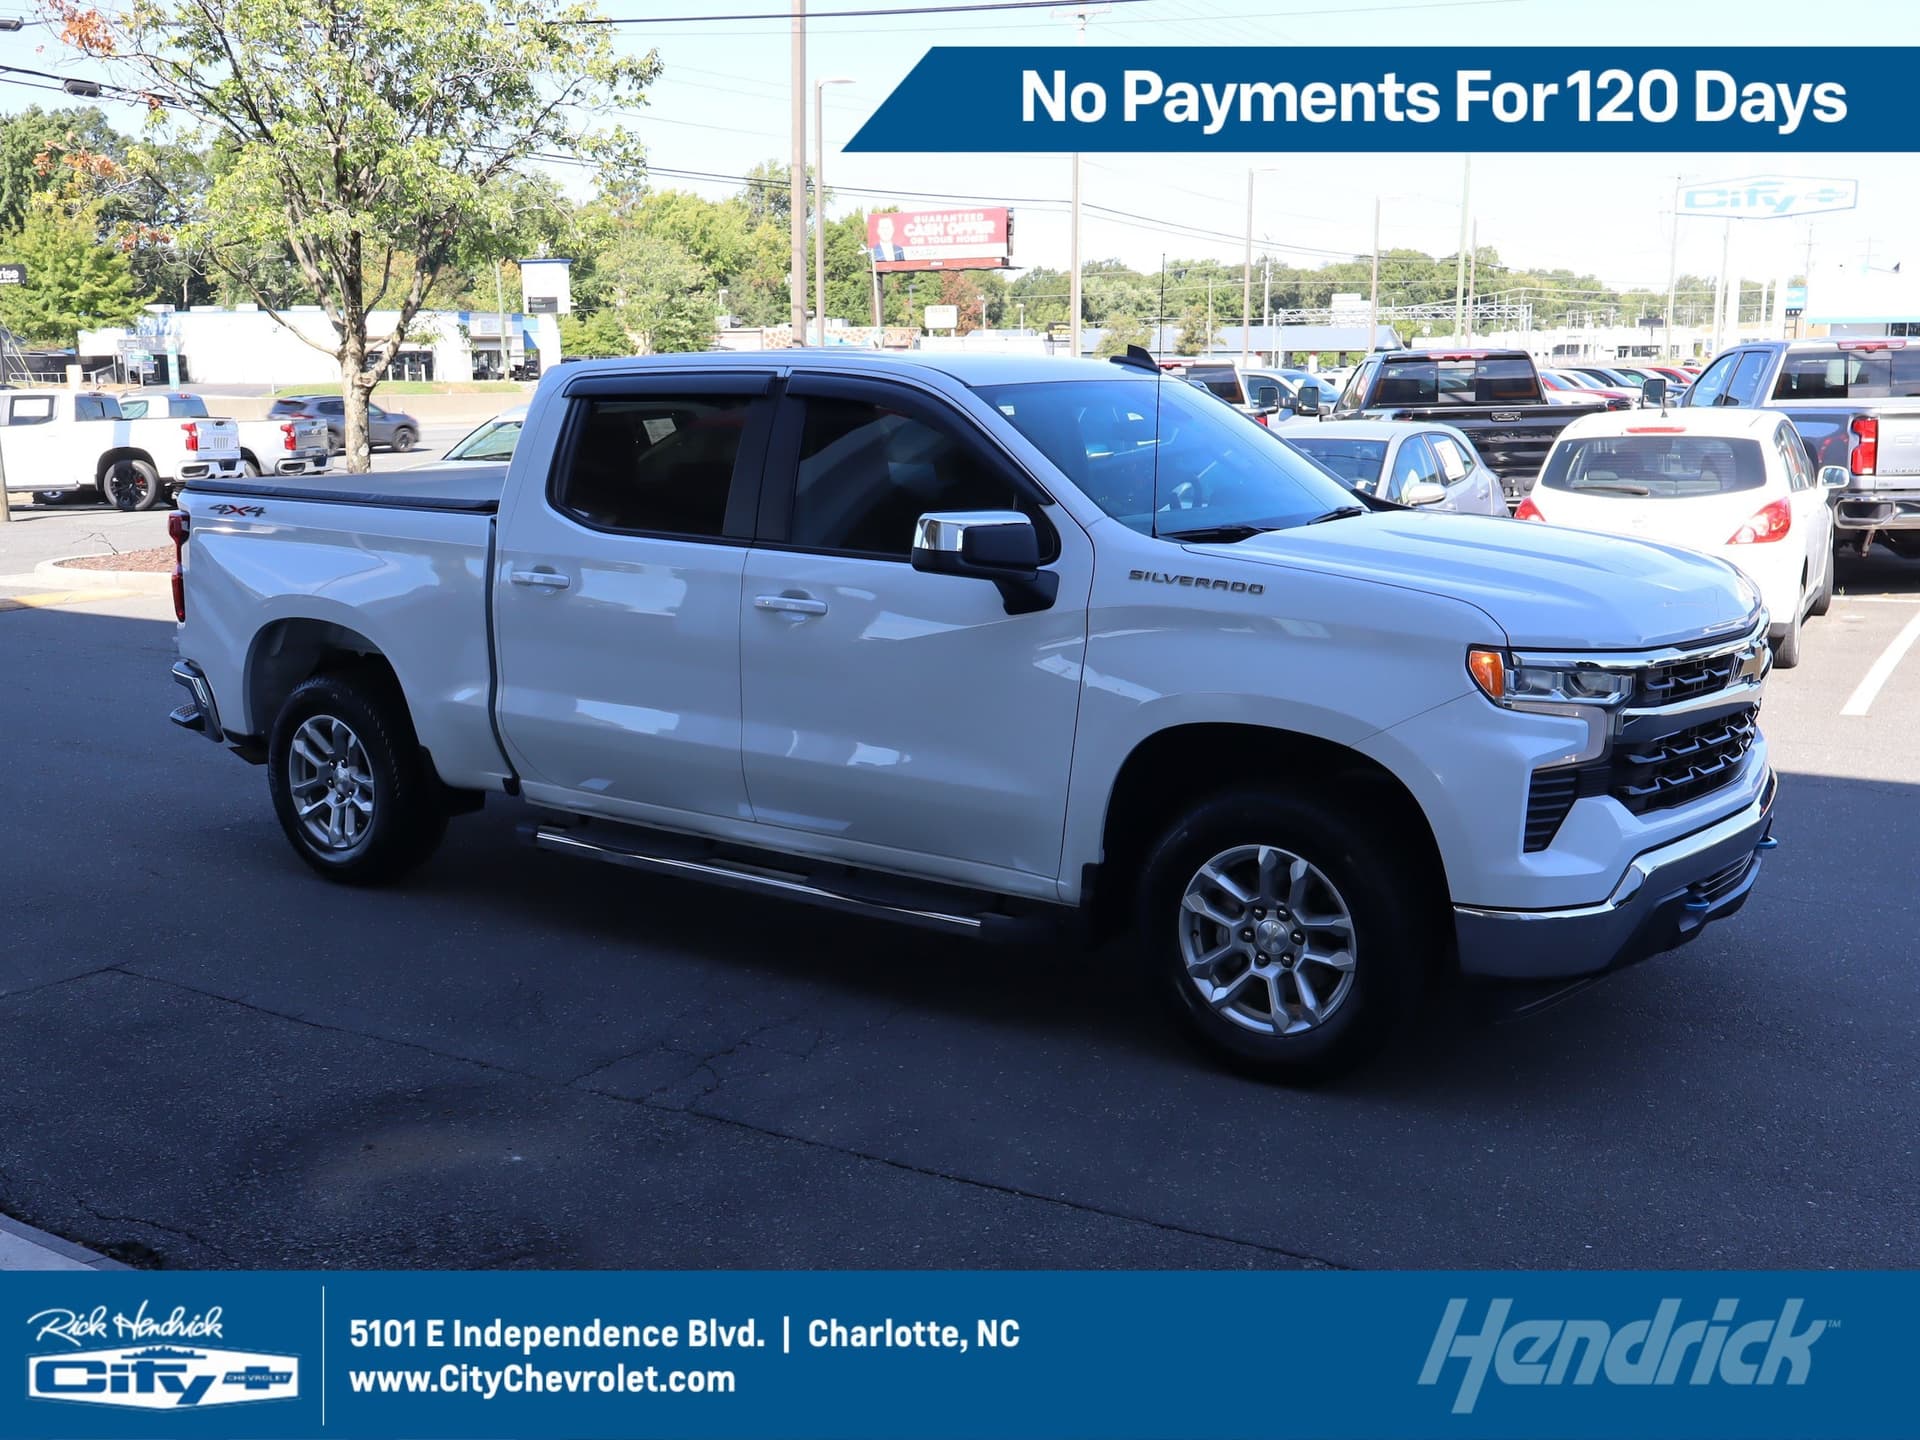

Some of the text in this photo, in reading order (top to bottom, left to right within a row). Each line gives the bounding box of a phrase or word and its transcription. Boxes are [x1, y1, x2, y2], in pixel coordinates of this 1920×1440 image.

[1684, 188, 1797, 213] City
[904, 220, 996, 237] CASH OFFER
[913, 212, 984, 224] GUARANTEED
[1129, 569, 1265, 595] SILVERADO
